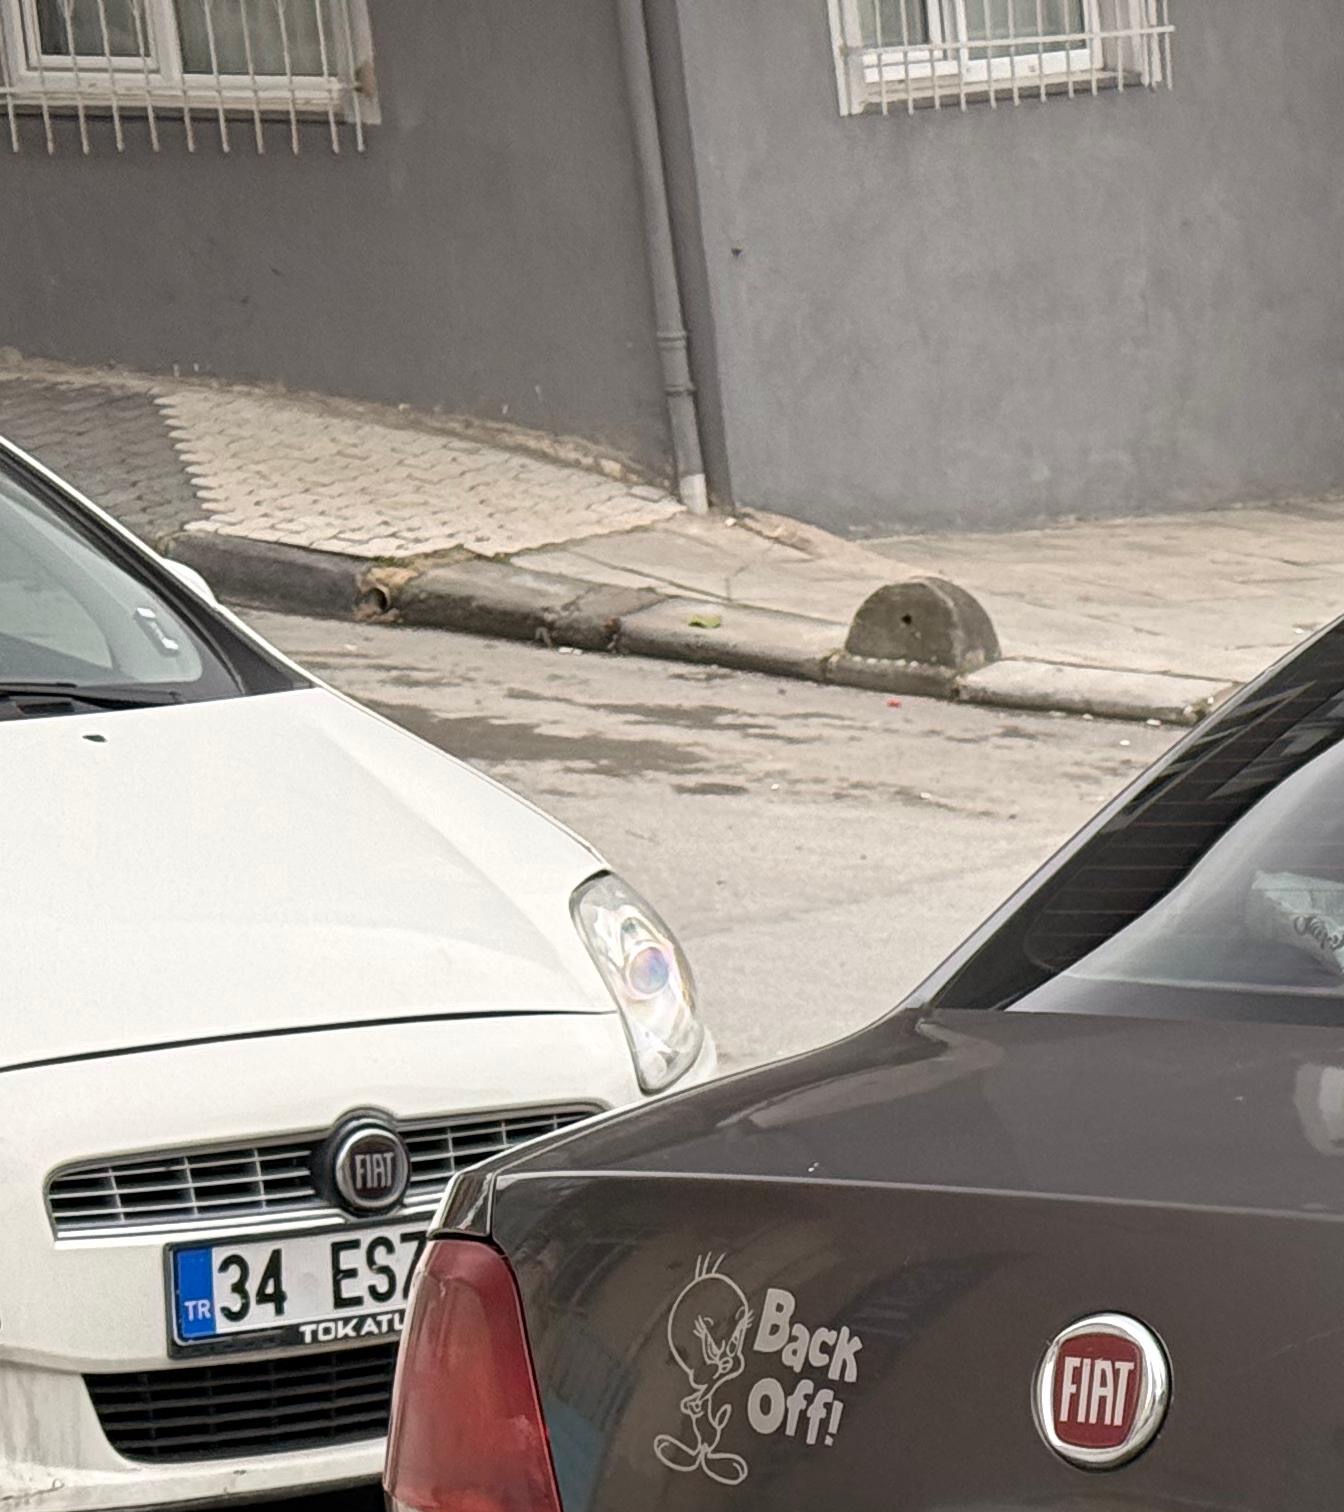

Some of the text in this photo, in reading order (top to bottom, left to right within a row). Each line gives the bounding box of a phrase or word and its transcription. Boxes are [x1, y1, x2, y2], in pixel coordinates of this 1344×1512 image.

[354, 1152, 394, 1189] FIAT
[184, 1300, 212, 1321] TR
[218, 1249, 287, 1322] 34
[754, 1288, 863, 1383] Back
[747, 1378, 844, 1446] Off!
[1058, 1356, 1135, 1426] FIAT
